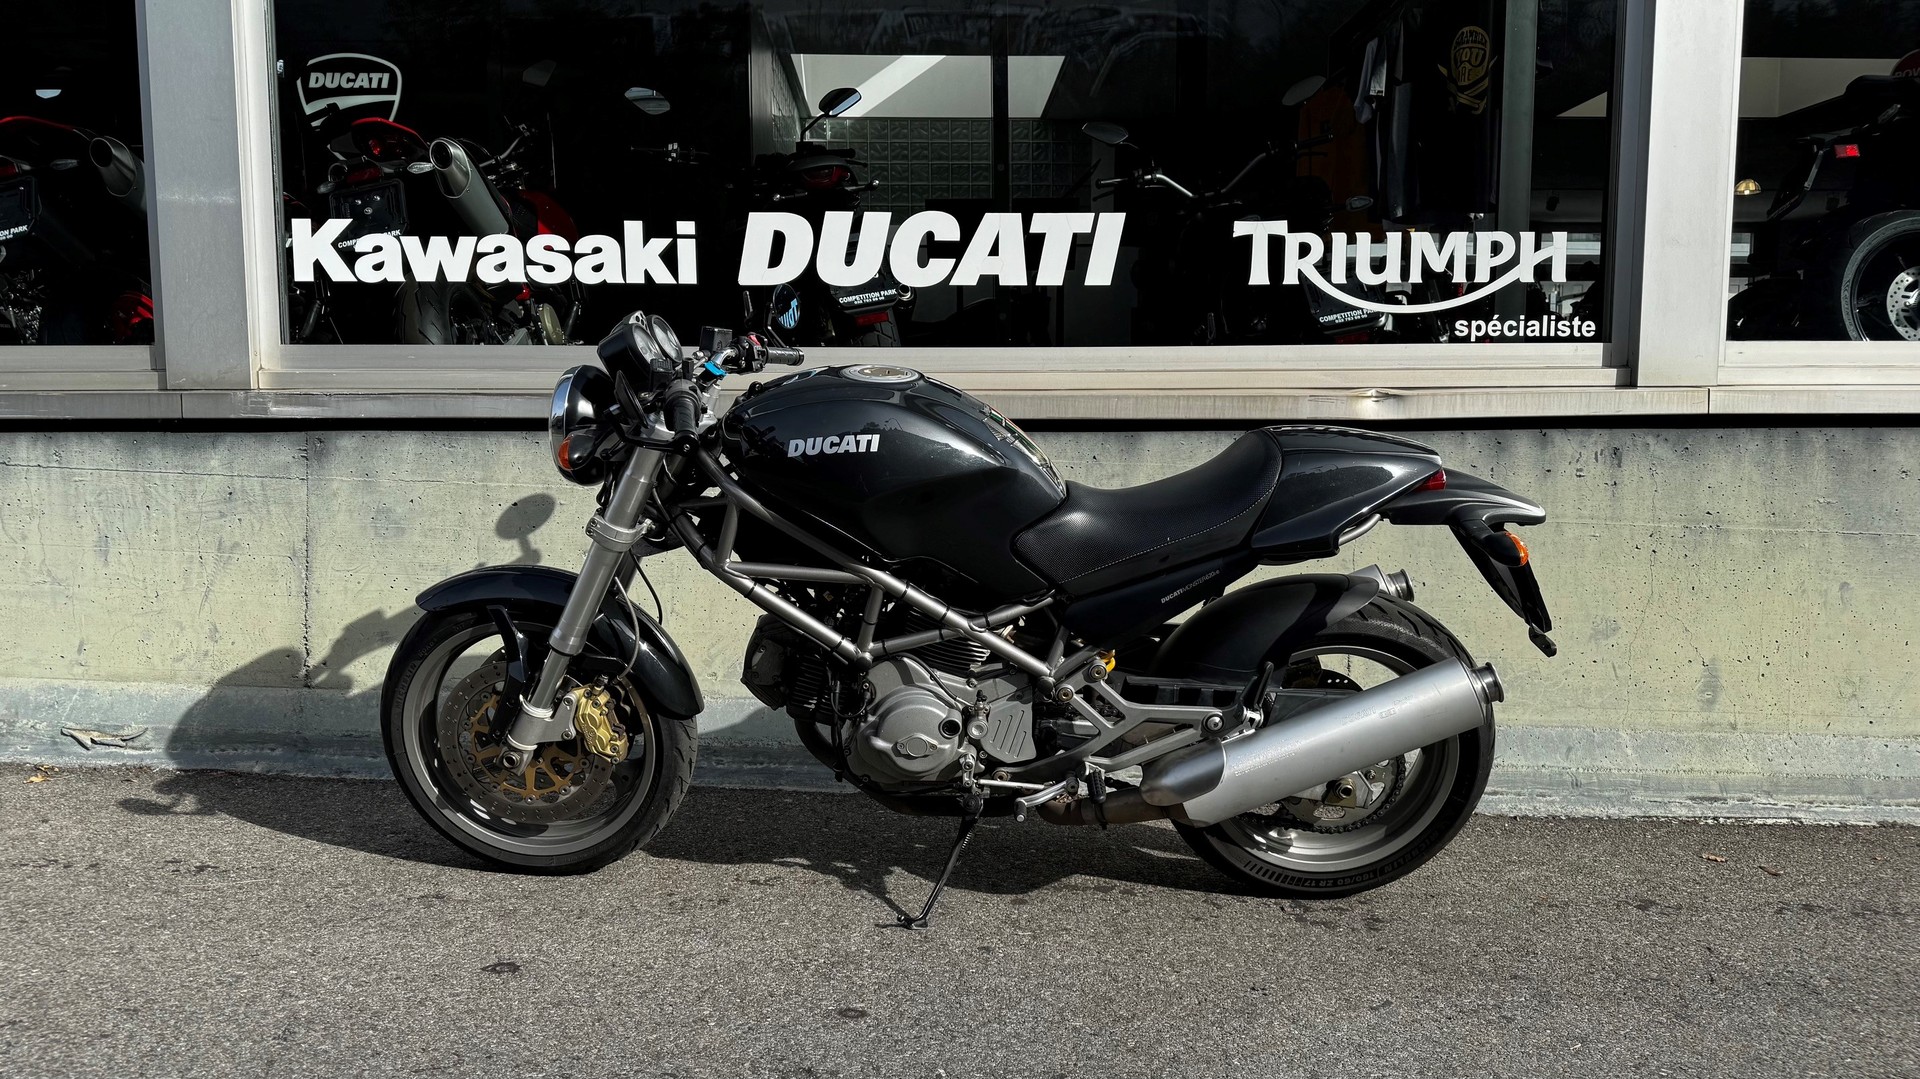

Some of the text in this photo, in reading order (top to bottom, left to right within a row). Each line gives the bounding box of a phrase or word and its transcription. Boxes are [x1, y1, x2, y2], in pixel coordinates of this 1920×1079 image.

[308, 72, 390, 89] DUCATI
[10, 225, 28, 235] PARK
[291, 219, 697, 285] Kawasaki
[738, 211, 1126, 287] DUCATI
[1233, 220, 1567, 313] TRIUMPH
[839, 288, 897, 304] COMPETITION PARK
[1319, 309, 1363, 323] COMPETITION
[1454, 314, 1597, 338] spécialiste
[788, 434, 880, 457] DUCATI
